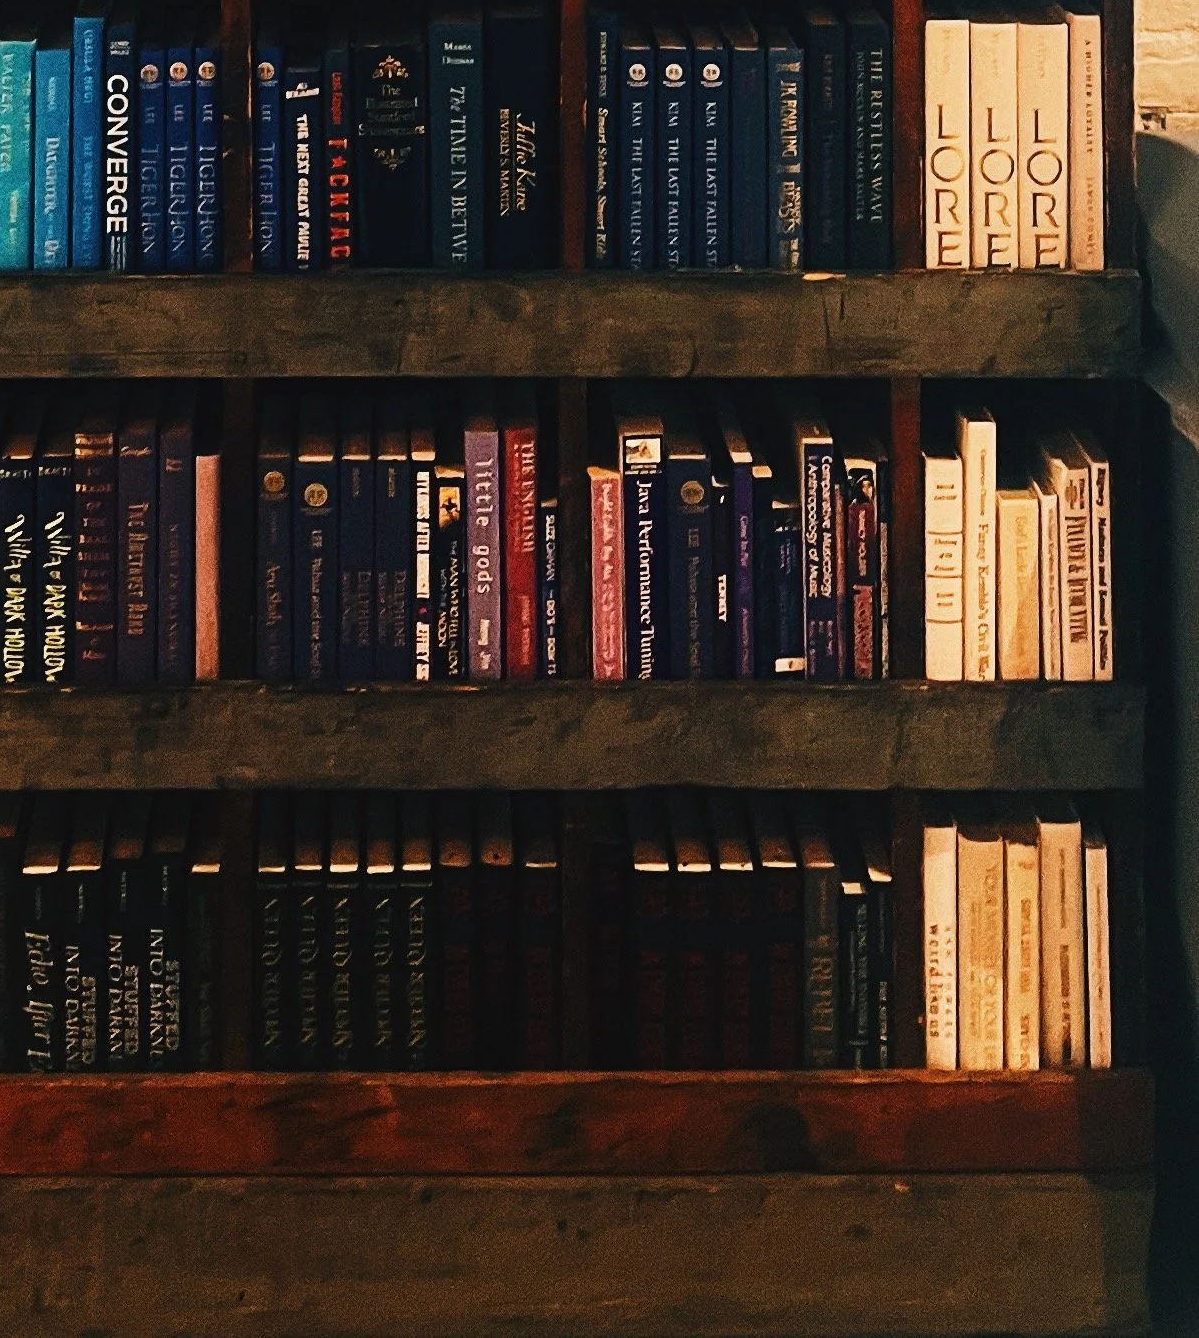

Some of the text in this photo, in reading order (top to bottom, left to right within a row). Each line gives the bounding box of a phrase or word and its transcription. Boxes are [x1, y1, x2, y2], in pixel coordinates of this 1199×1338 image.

[106, 74, 128, 234] CONVERGE
[450, 86, 465, 111] The
[451, 116, 466, 163] TIME
[870, 49, 882, 170] THE RESTLESS
[297, 114, 309, 260] THE NEXT GREAT PAULIE
[452, 170, 466, 189] IN
[706, 102, 717, 245] KIM THE LAST FALLEN
[931, 104, 965, 266] LORE
[980, 108, 1015, 268] LORE
[1027, 108, 1062, 269] LORE
[473, 459, 493, 594] little gods
[637, 481, 653, 514] Java
[820, 456, 832, 598] Comparative Musicology
[639, 520, 653, 622] Performance
[149, 929, 163, 975] INTO
[165, 959, 180, 1049] STUFFED
